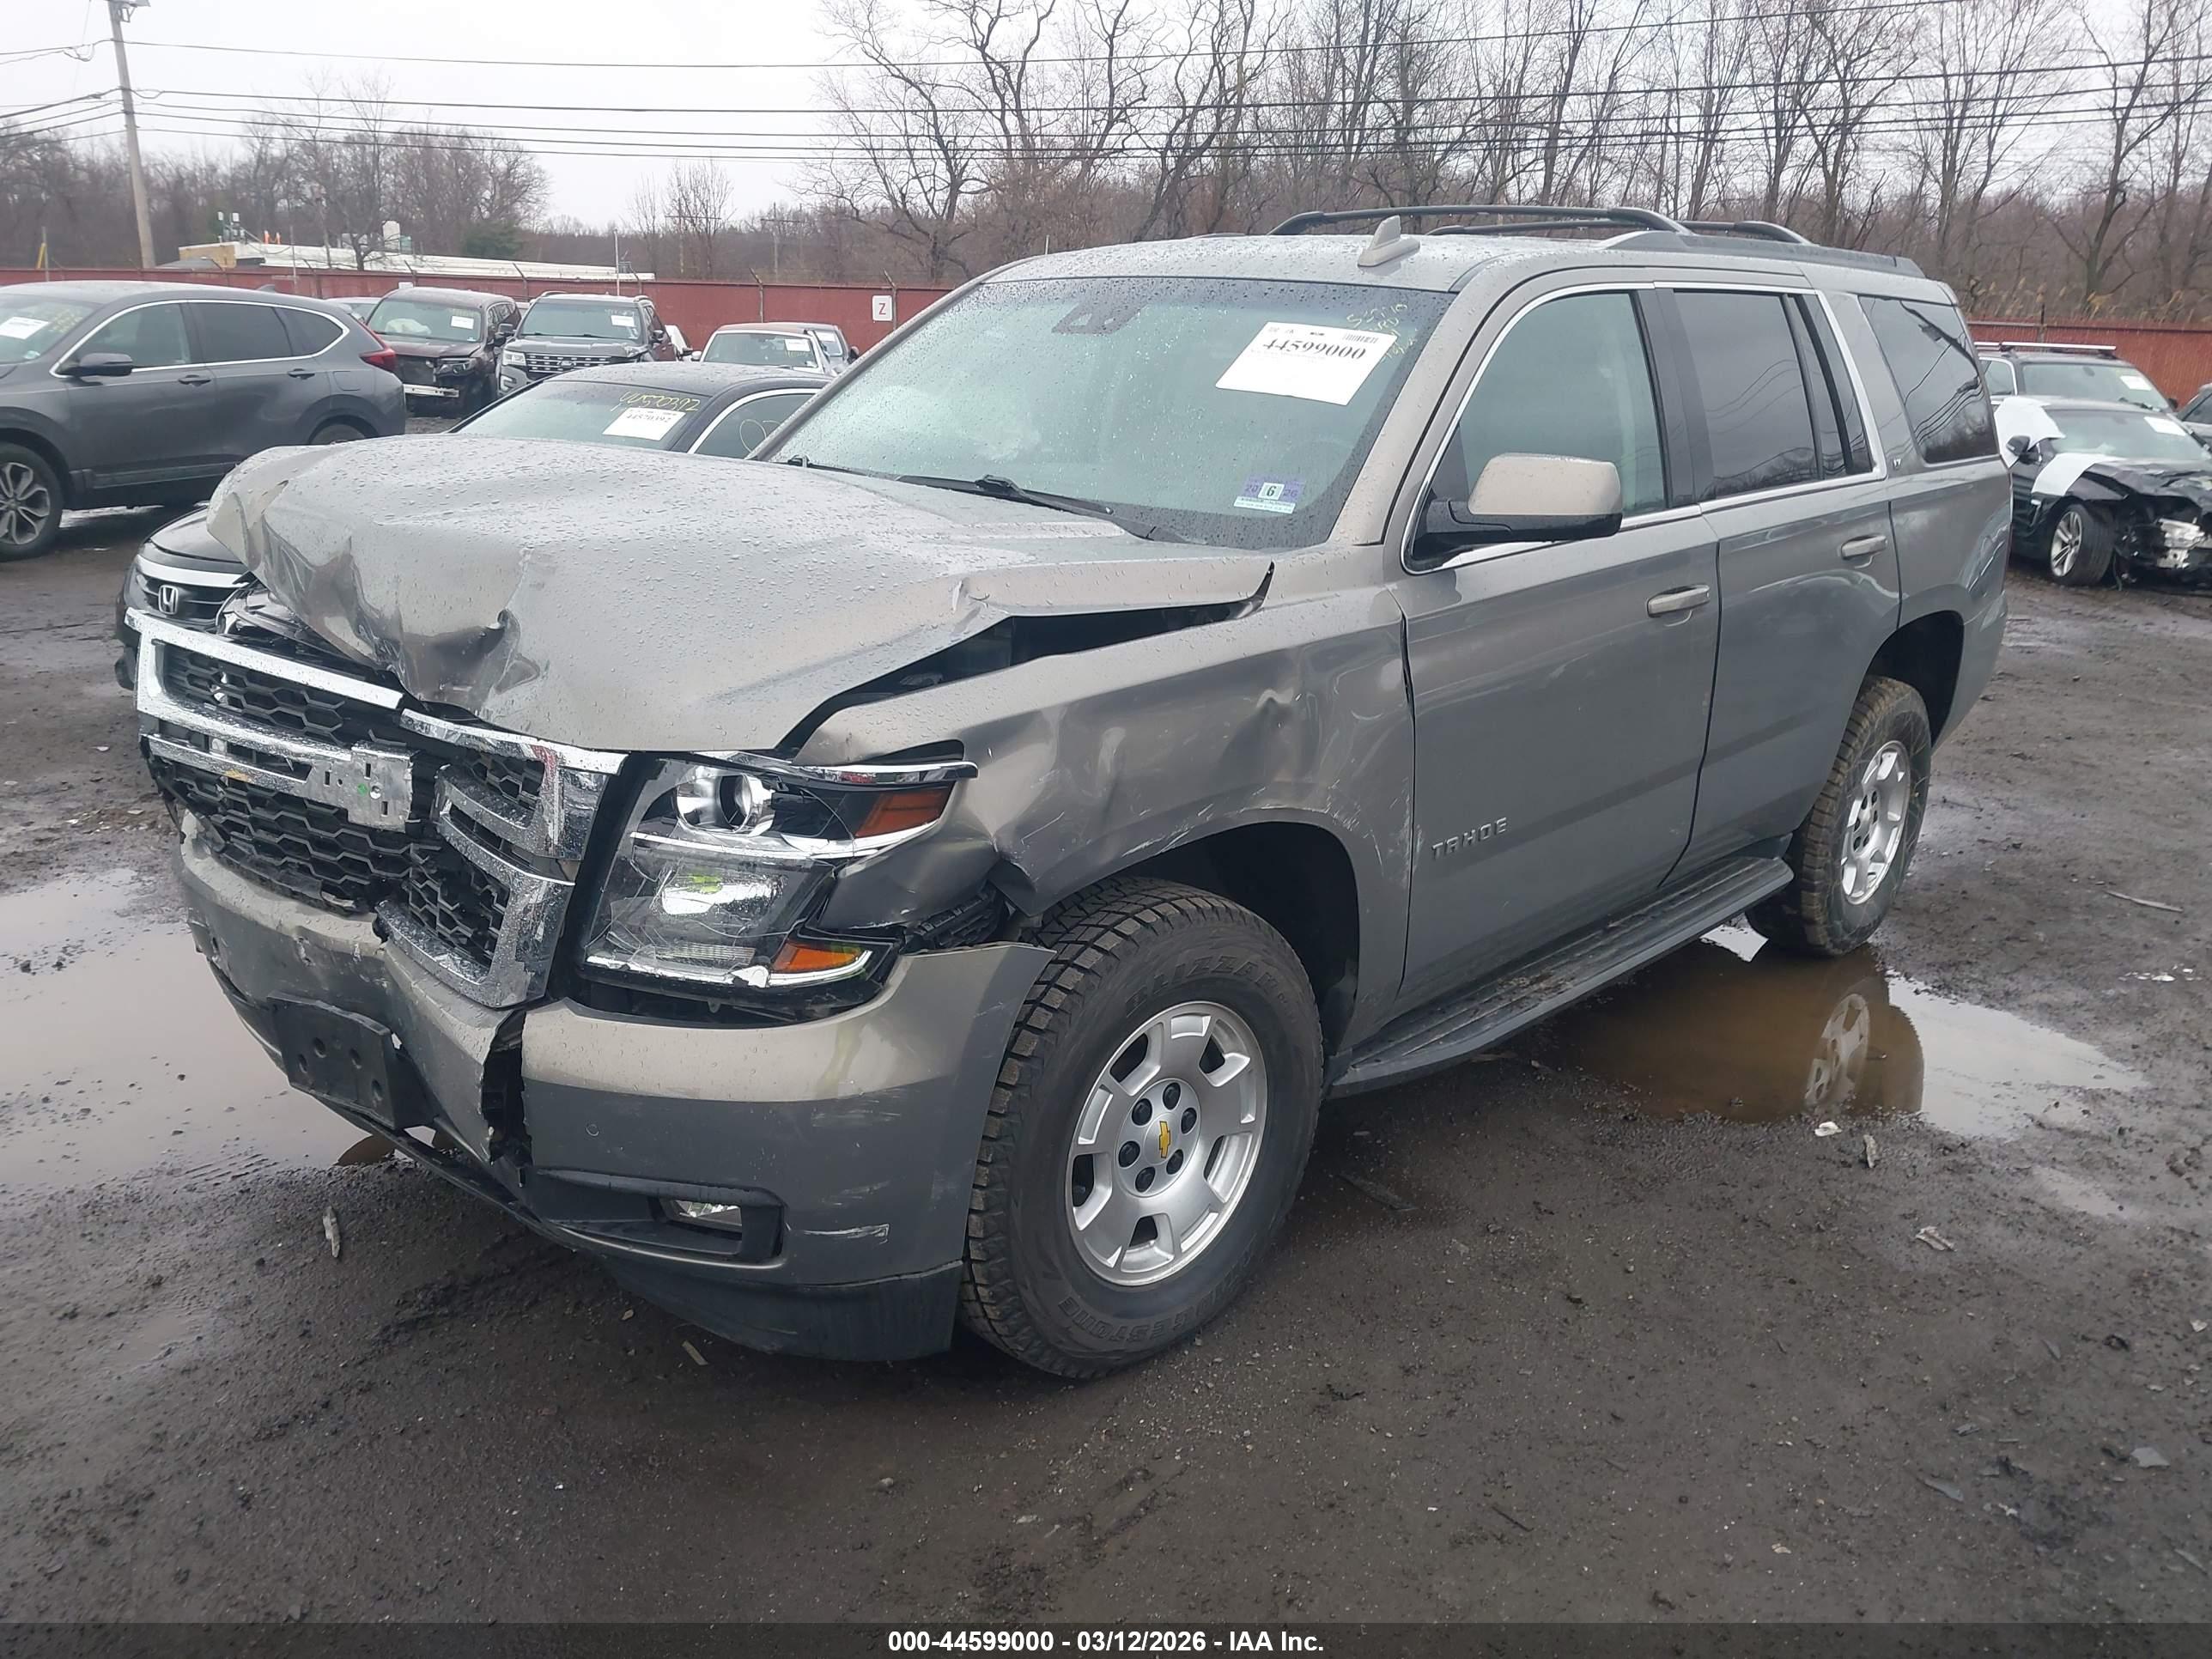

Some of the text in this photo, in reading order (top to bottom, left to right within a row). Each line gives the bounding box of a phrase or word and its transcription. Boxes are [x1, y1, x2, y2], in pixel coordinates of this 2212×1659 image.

[878, 303, 886, 315] Z
[1262, 338, 1367, 360] 44599000
[1267, 485, 1277, 497] 6
[1431, 817, 1507, 860] TAHOE
